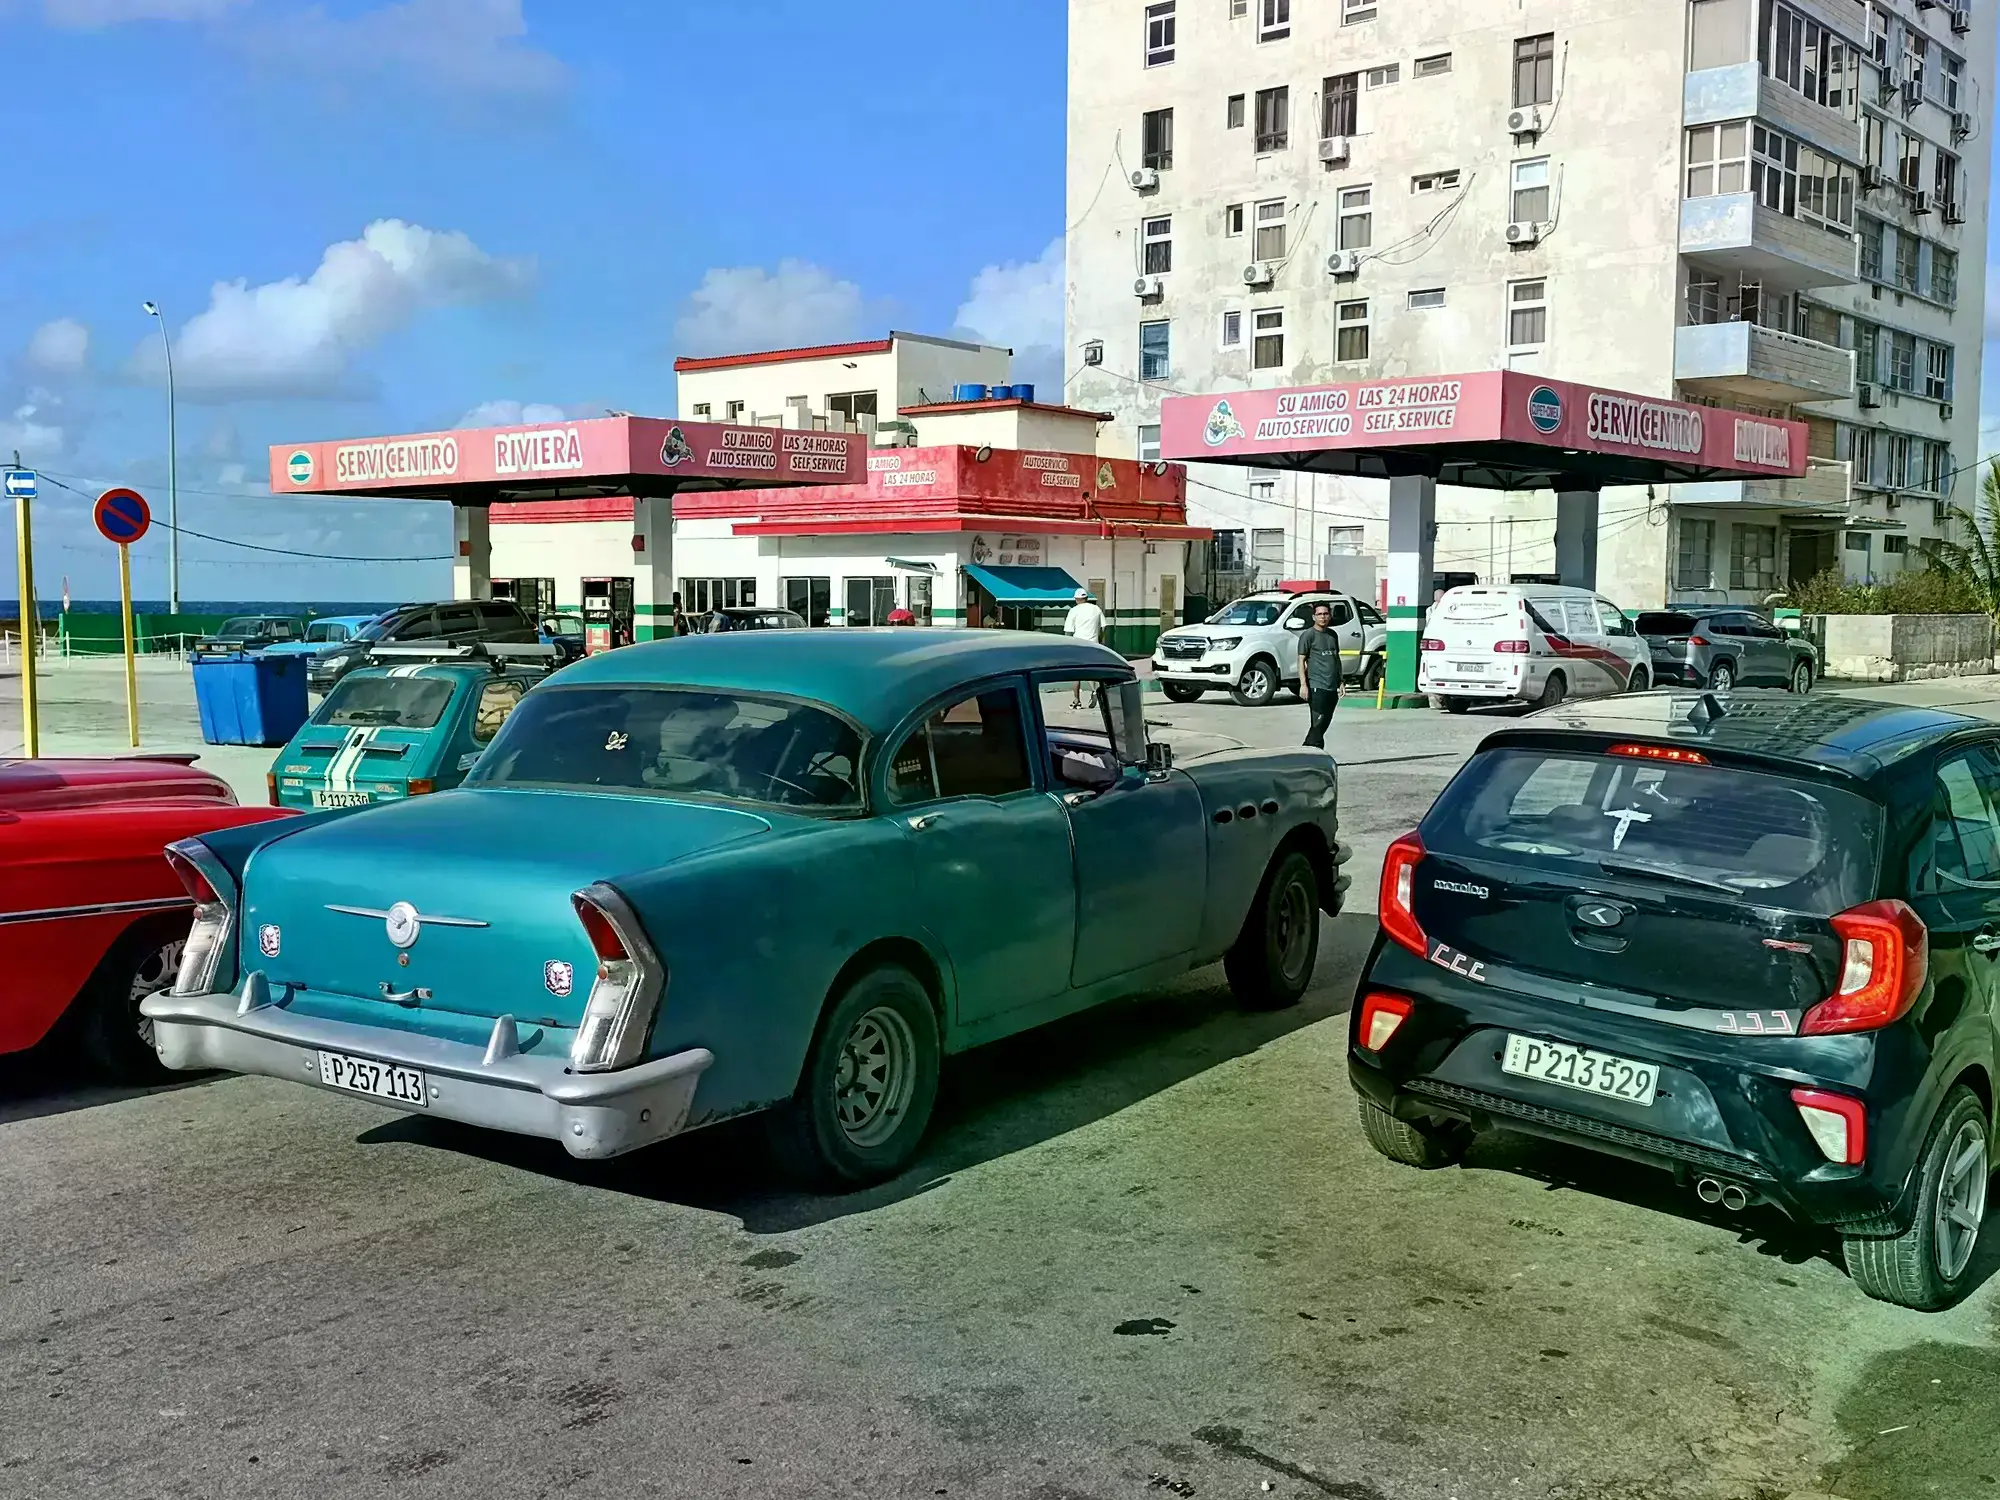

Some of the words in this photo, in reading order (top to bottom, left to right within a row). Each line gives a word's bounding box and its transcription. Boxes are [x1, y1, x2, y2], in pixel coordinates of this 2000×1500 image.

[1279, 396, 1296, 413] SU
[1299, 392, 1347, 412] AMIGO
[1358, 389, 1383, 406] LAS
[1388, 388, 1405, 405] 24
[1408, 383, 1459, 403] HORAS
[1366, 413, 1394, 430] SELF
[1397, 409, 1453, 428] SERVICE
[1590, 397, 1701, 450] SERVICENTRO
[497, 435, 580, 467] RIVIERA
[724, 432, 737, 447] SU
[739, 433, 772, 448] AMIGO
[784, 437, 800, 450] LAS
[802, 438, 814, 452] 24
[815, 439, 847, 453] HORAS
[338, 442, 456, 477] SERVICENTRO
[792, 456, 811, 470] SELF
[812, 457, 846, 472] SERVICE
[875, 458, 900, 469] AMIGO
[884, 474, 897, 485] LAS
[899, 473, 909, 484] 24
[909, 471, 935, 484] HORAS
